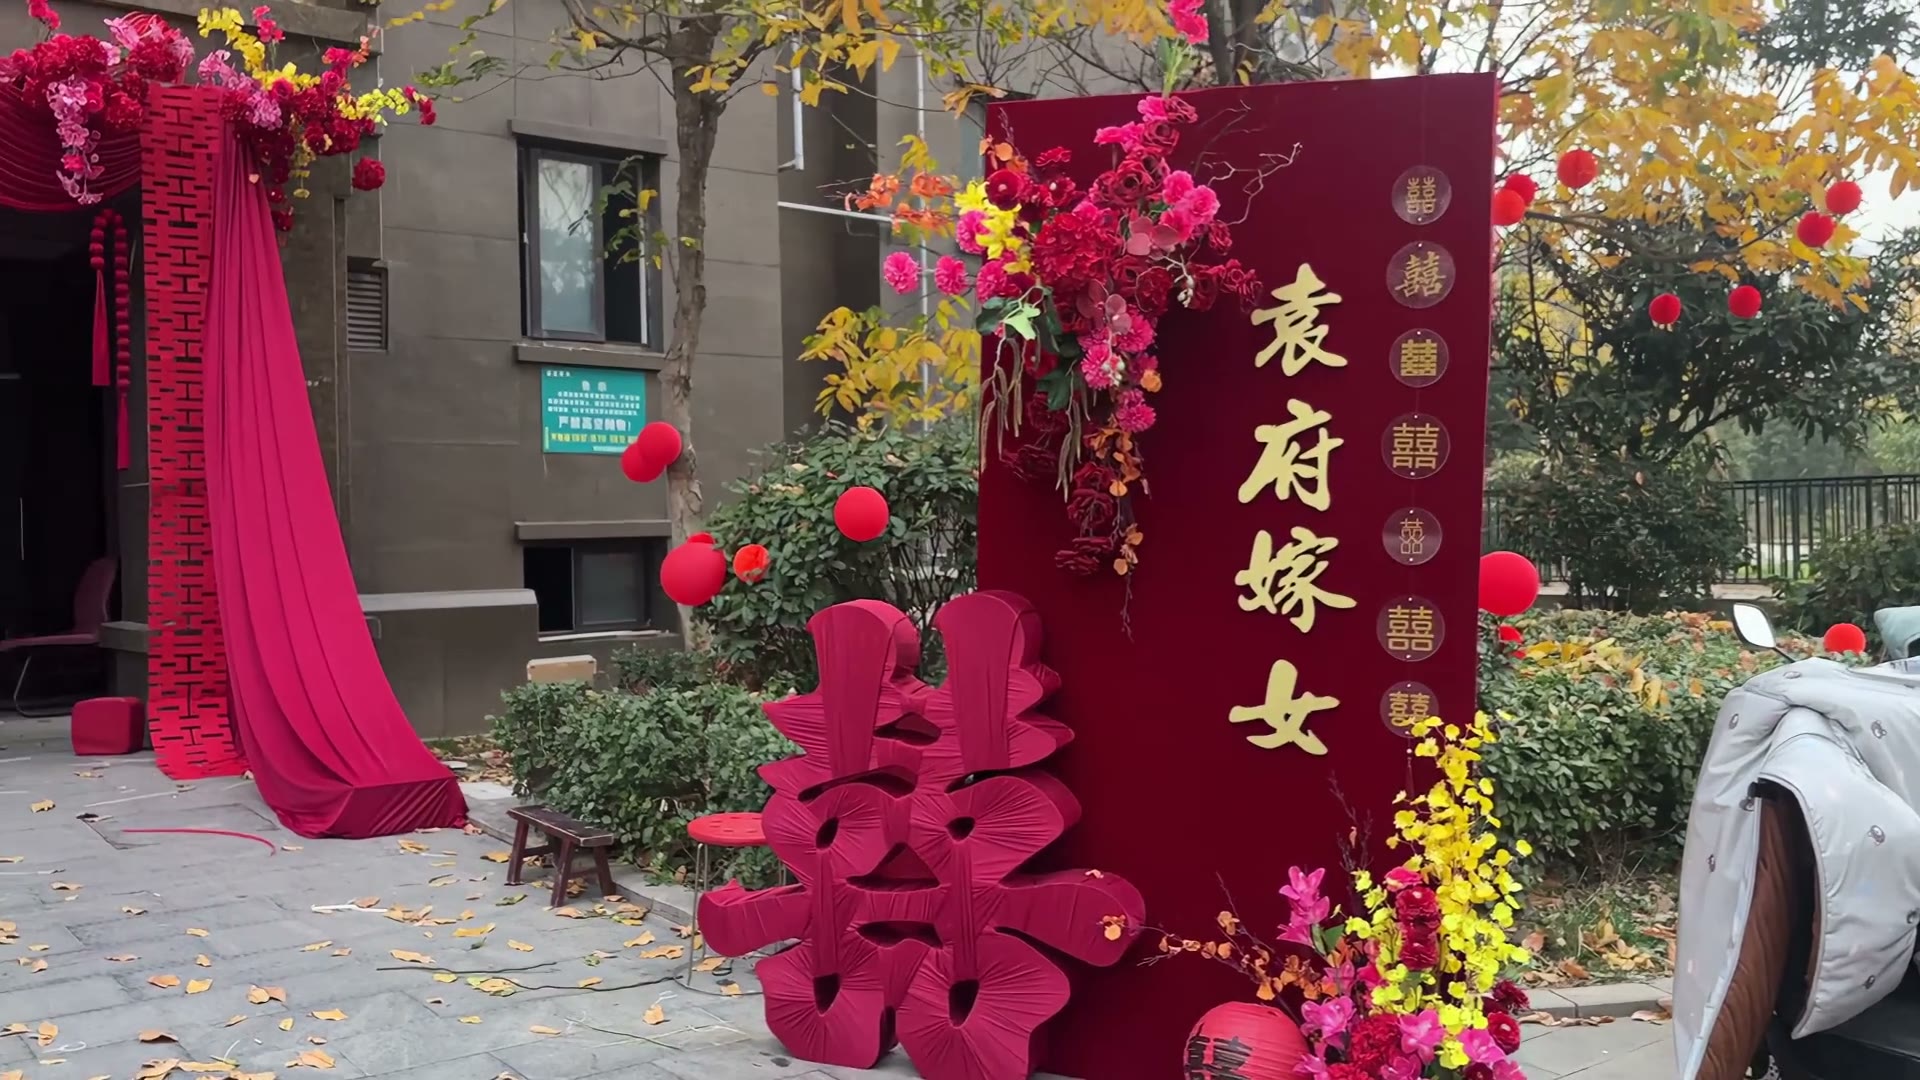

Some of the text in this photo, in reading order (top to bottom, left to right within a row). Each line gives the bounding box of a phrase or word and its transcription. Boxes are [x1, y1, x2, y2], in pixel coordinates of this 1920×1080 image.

[1407, 176, 1437, 214] 囍
[1395, 251, 1447, 298] 囍
[1401, 339, 1438, 377] 囍
[1391, 423, 1440, 469] 囍
[1228, 263, 1358, 756] 袁府嫁女
[1386, 605, 1435, 652] 囍
